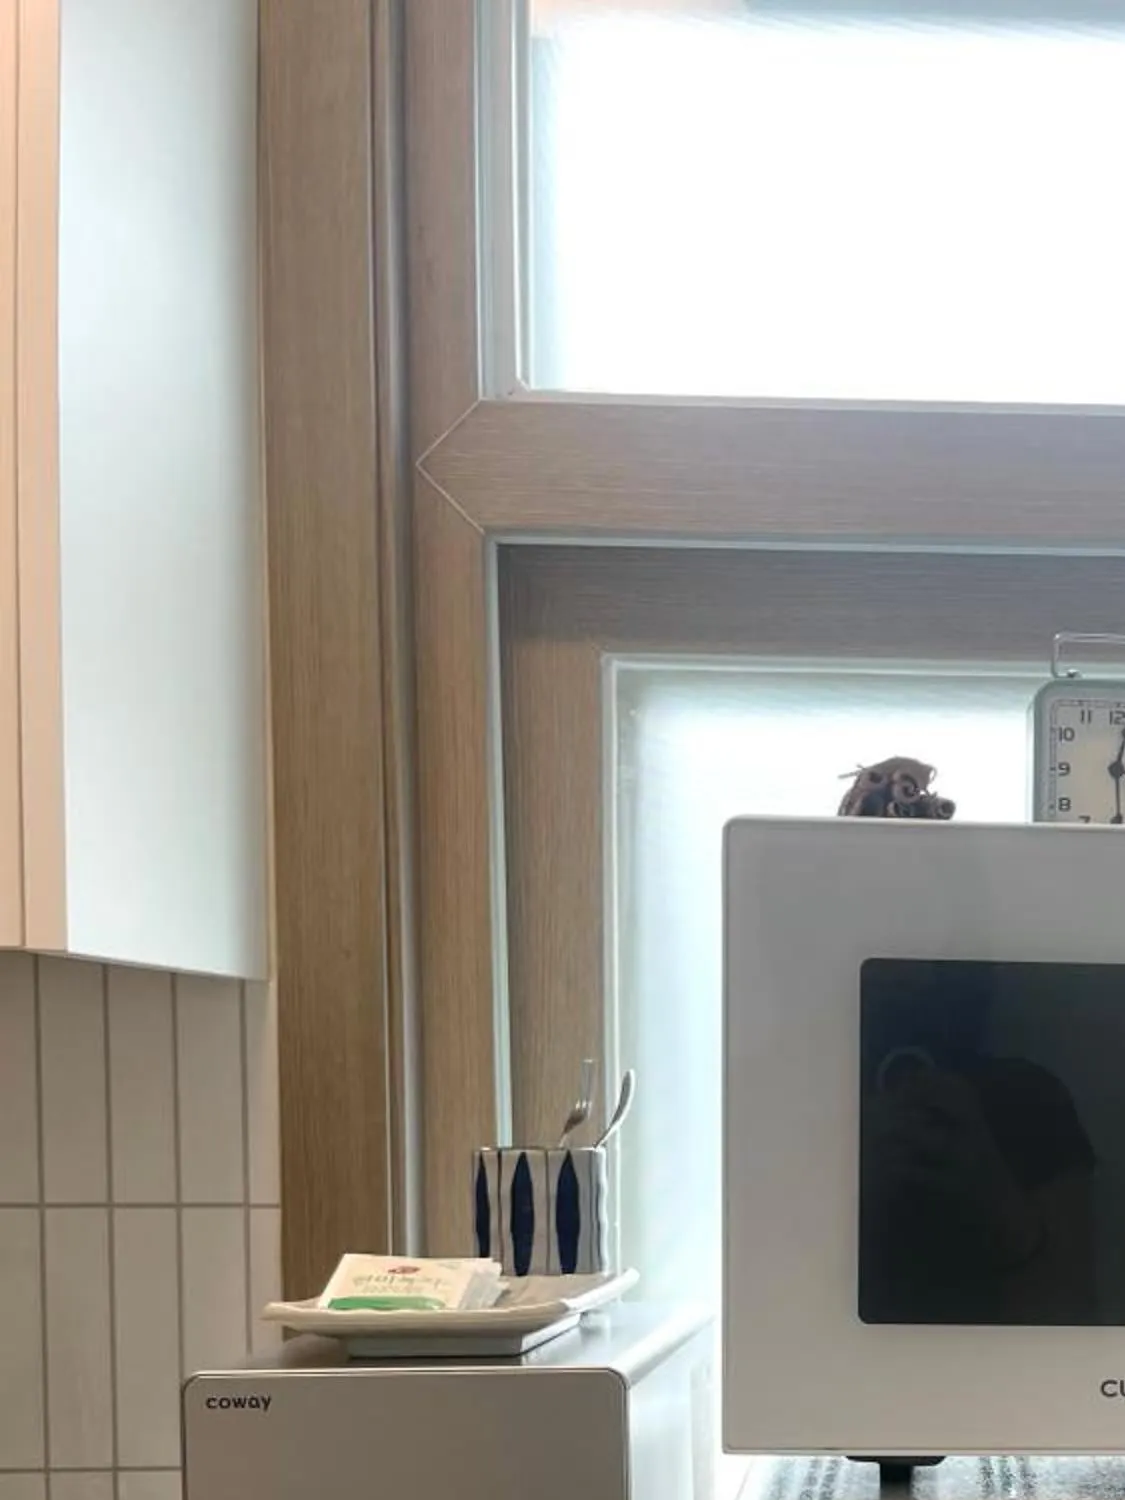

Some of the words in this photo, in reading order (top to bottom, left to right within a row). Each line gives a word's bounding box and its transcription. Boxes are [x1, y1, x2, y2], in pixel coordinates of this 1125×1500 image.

[1080, 709, 1092, 724] 11
[1058, 727, 1075, 741] 10
[1058, 762, 1071, 776] 9
[1058, 797, 1071, 812] 8
[205, 1395, 272, 1411] coway
